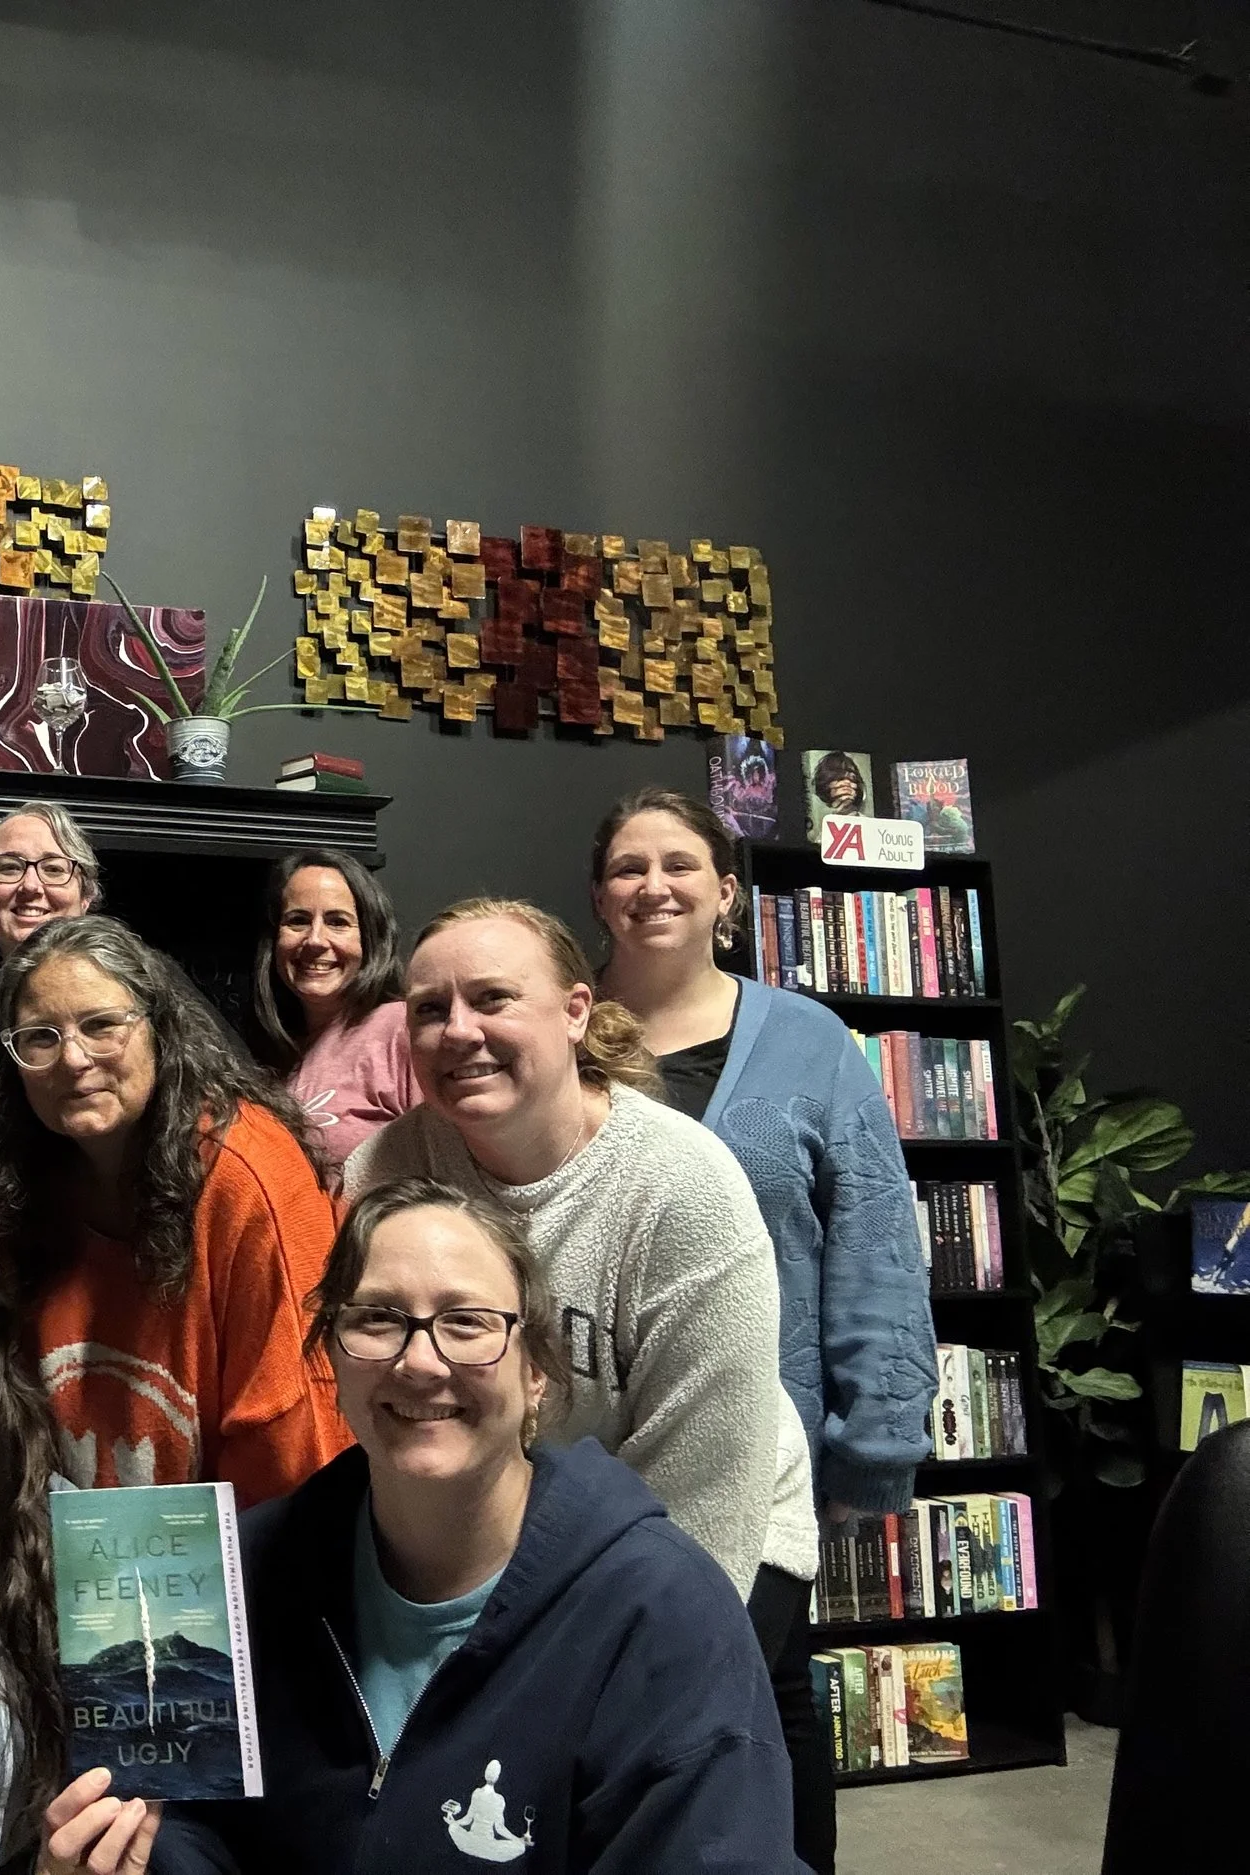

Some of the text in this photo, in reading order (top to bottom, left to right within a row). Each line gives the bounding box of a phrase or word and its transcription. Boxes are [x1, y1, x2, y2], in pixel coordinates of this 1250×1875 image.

[708, 756, 726, 825] OATHBOUN
[909, 781, 960, 796] BLOOD
[823, 820, 866, 861] YA
[877, 828, 913, 847] YOUNG
[877, 847, 913, 863] ADULT
[800, 902, 810, 937] BEAUTIFUL
[923, 1069, 934, 1098] SHATTER
[934, 1064, 947, 1099] UNRAVEL
[947, 1069, 959, 1097] IGNITE
[963, 1070, 974, 1099] SHATTER
[224, 1511, 232, 1531] THE
[88, 1534, 189, 1561] ALICE
[909, 1537, 921, 1599] DIVERGENT
[73, 1571, 206, 1602] FEENEY
[236, 1648, 251, 1720] BESTSELLING
[853, 1666, 864, 1695] AFTER
[830, 1678, 843, 1759] AFTER ANNA TODD
[118, 1742, 193, 1767] UGLY
[243, 1725, 254, 1770] AUTHOR
